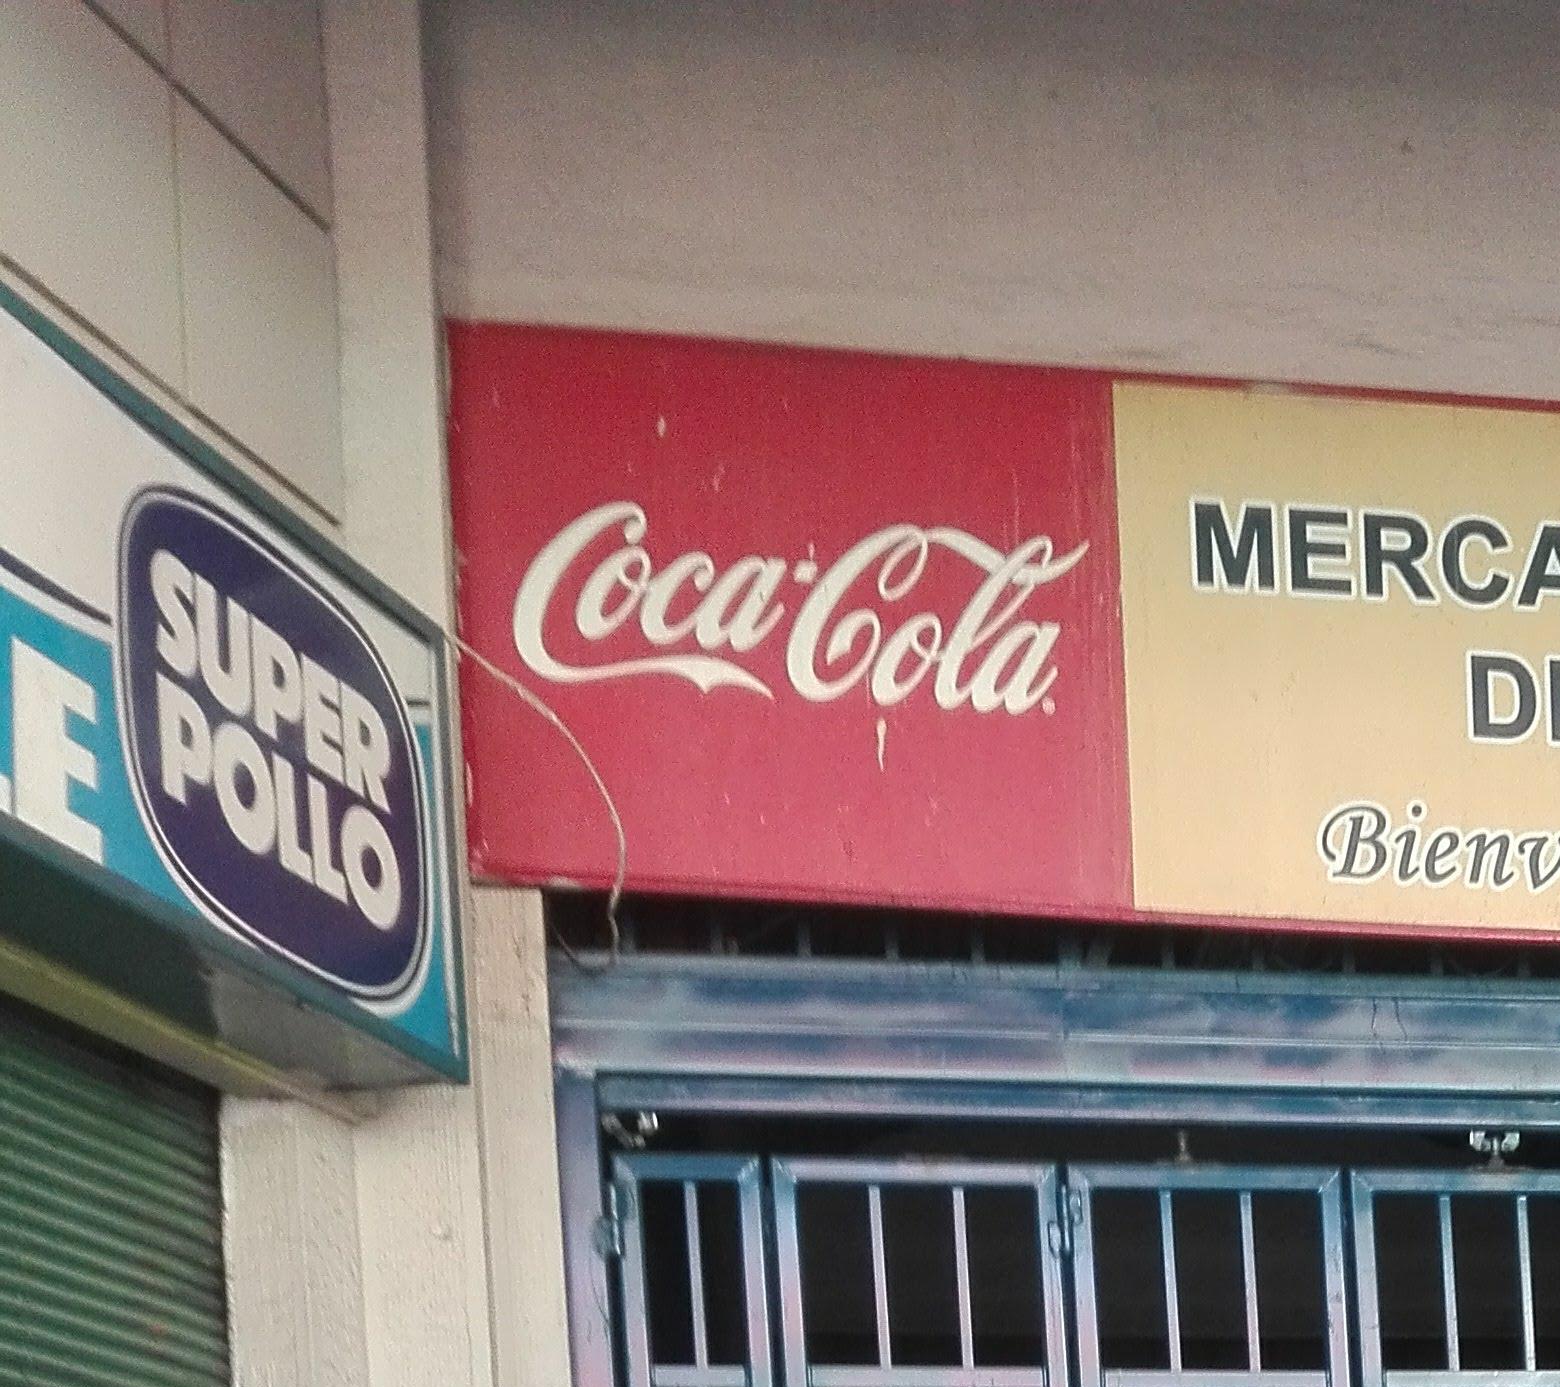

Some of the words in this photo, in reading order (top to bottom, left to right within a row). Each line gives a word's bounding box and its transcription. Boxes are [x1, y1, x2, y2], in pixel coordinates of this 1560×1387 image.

[0, 636, 103, 866] E
[150, 548, 392, 815] SUPER
[156, 671, 401, 931] POLLO
